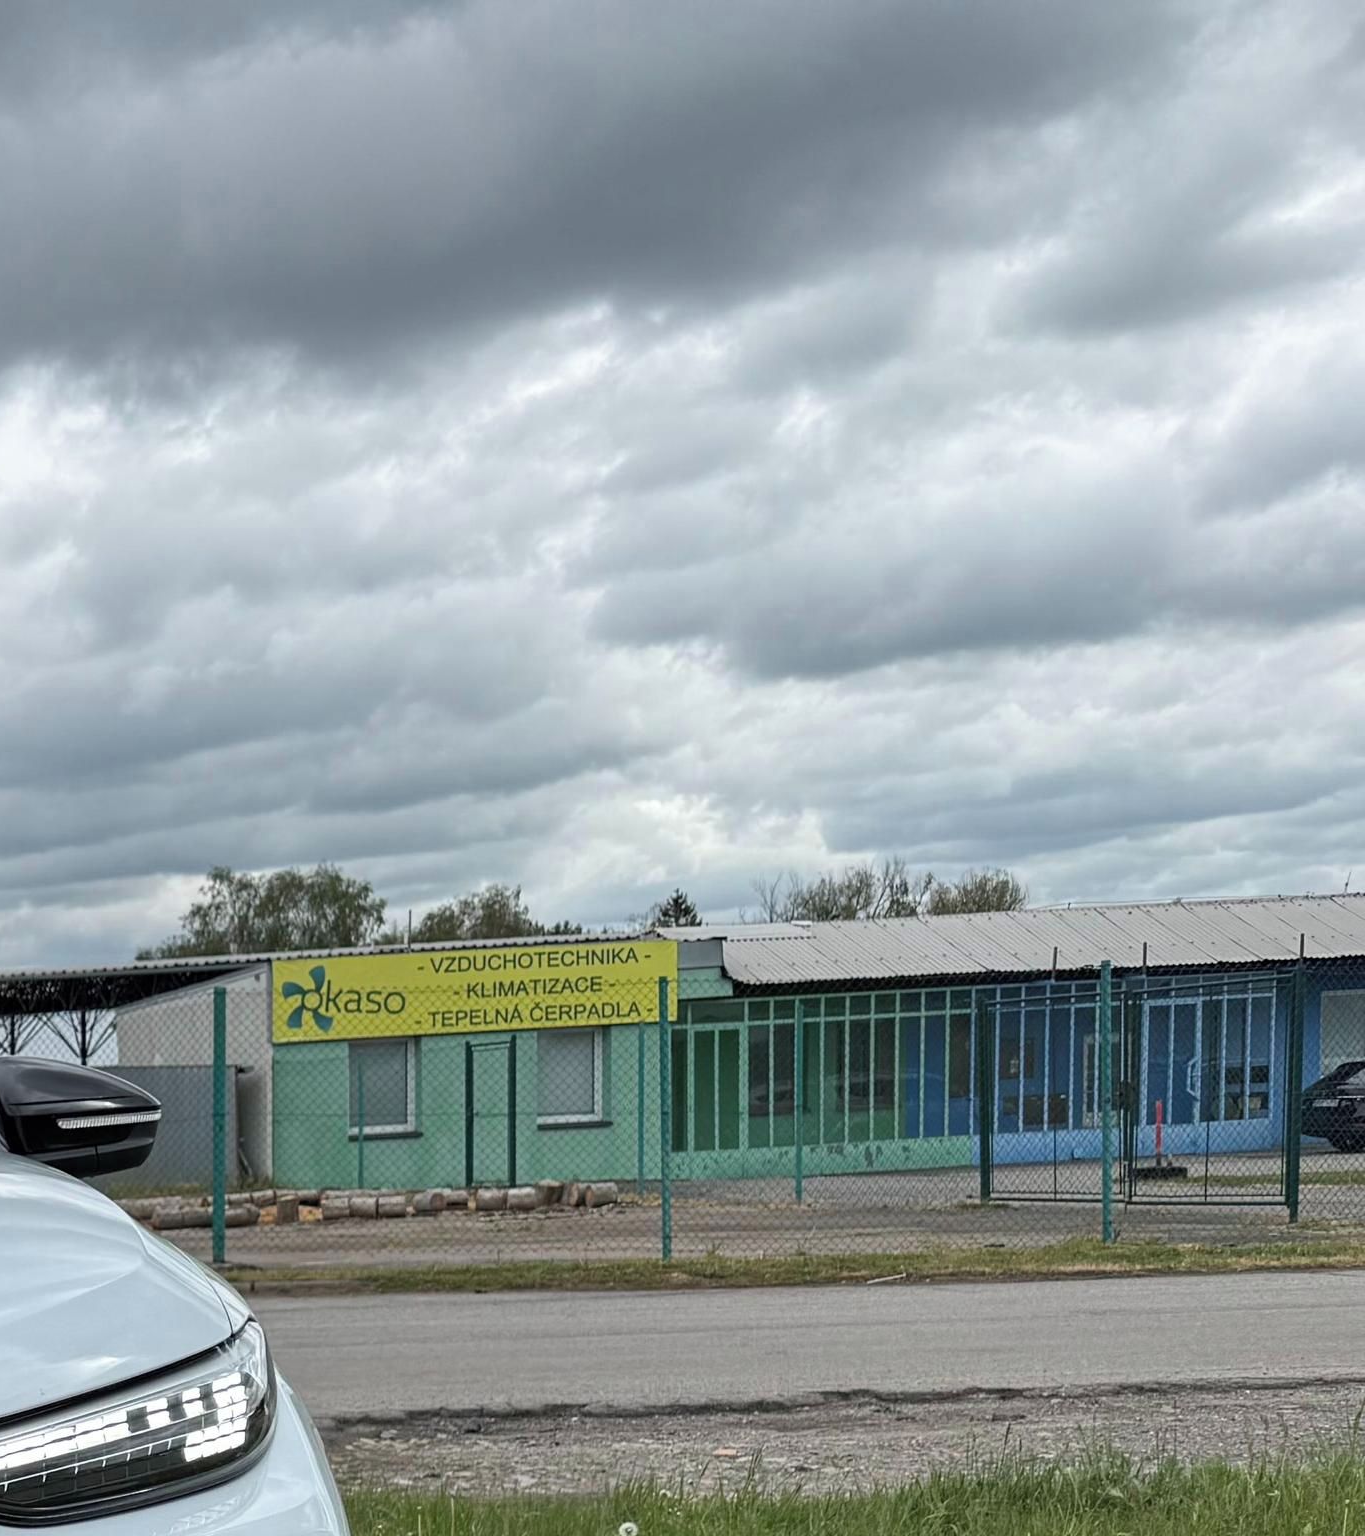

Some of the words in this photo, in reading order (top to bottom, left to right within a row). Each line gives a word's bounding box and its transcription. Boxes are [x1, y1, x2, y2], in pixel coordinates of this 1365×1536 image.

[429, 946, 639, 974] VZDUCHOTECHNIKA
[466, 975, 603, 999] KLIMATIZACE
[427, 1003, 524, 1028] TEPELNÁ
[529, 1001, 642, 1022] ČERPADLA
